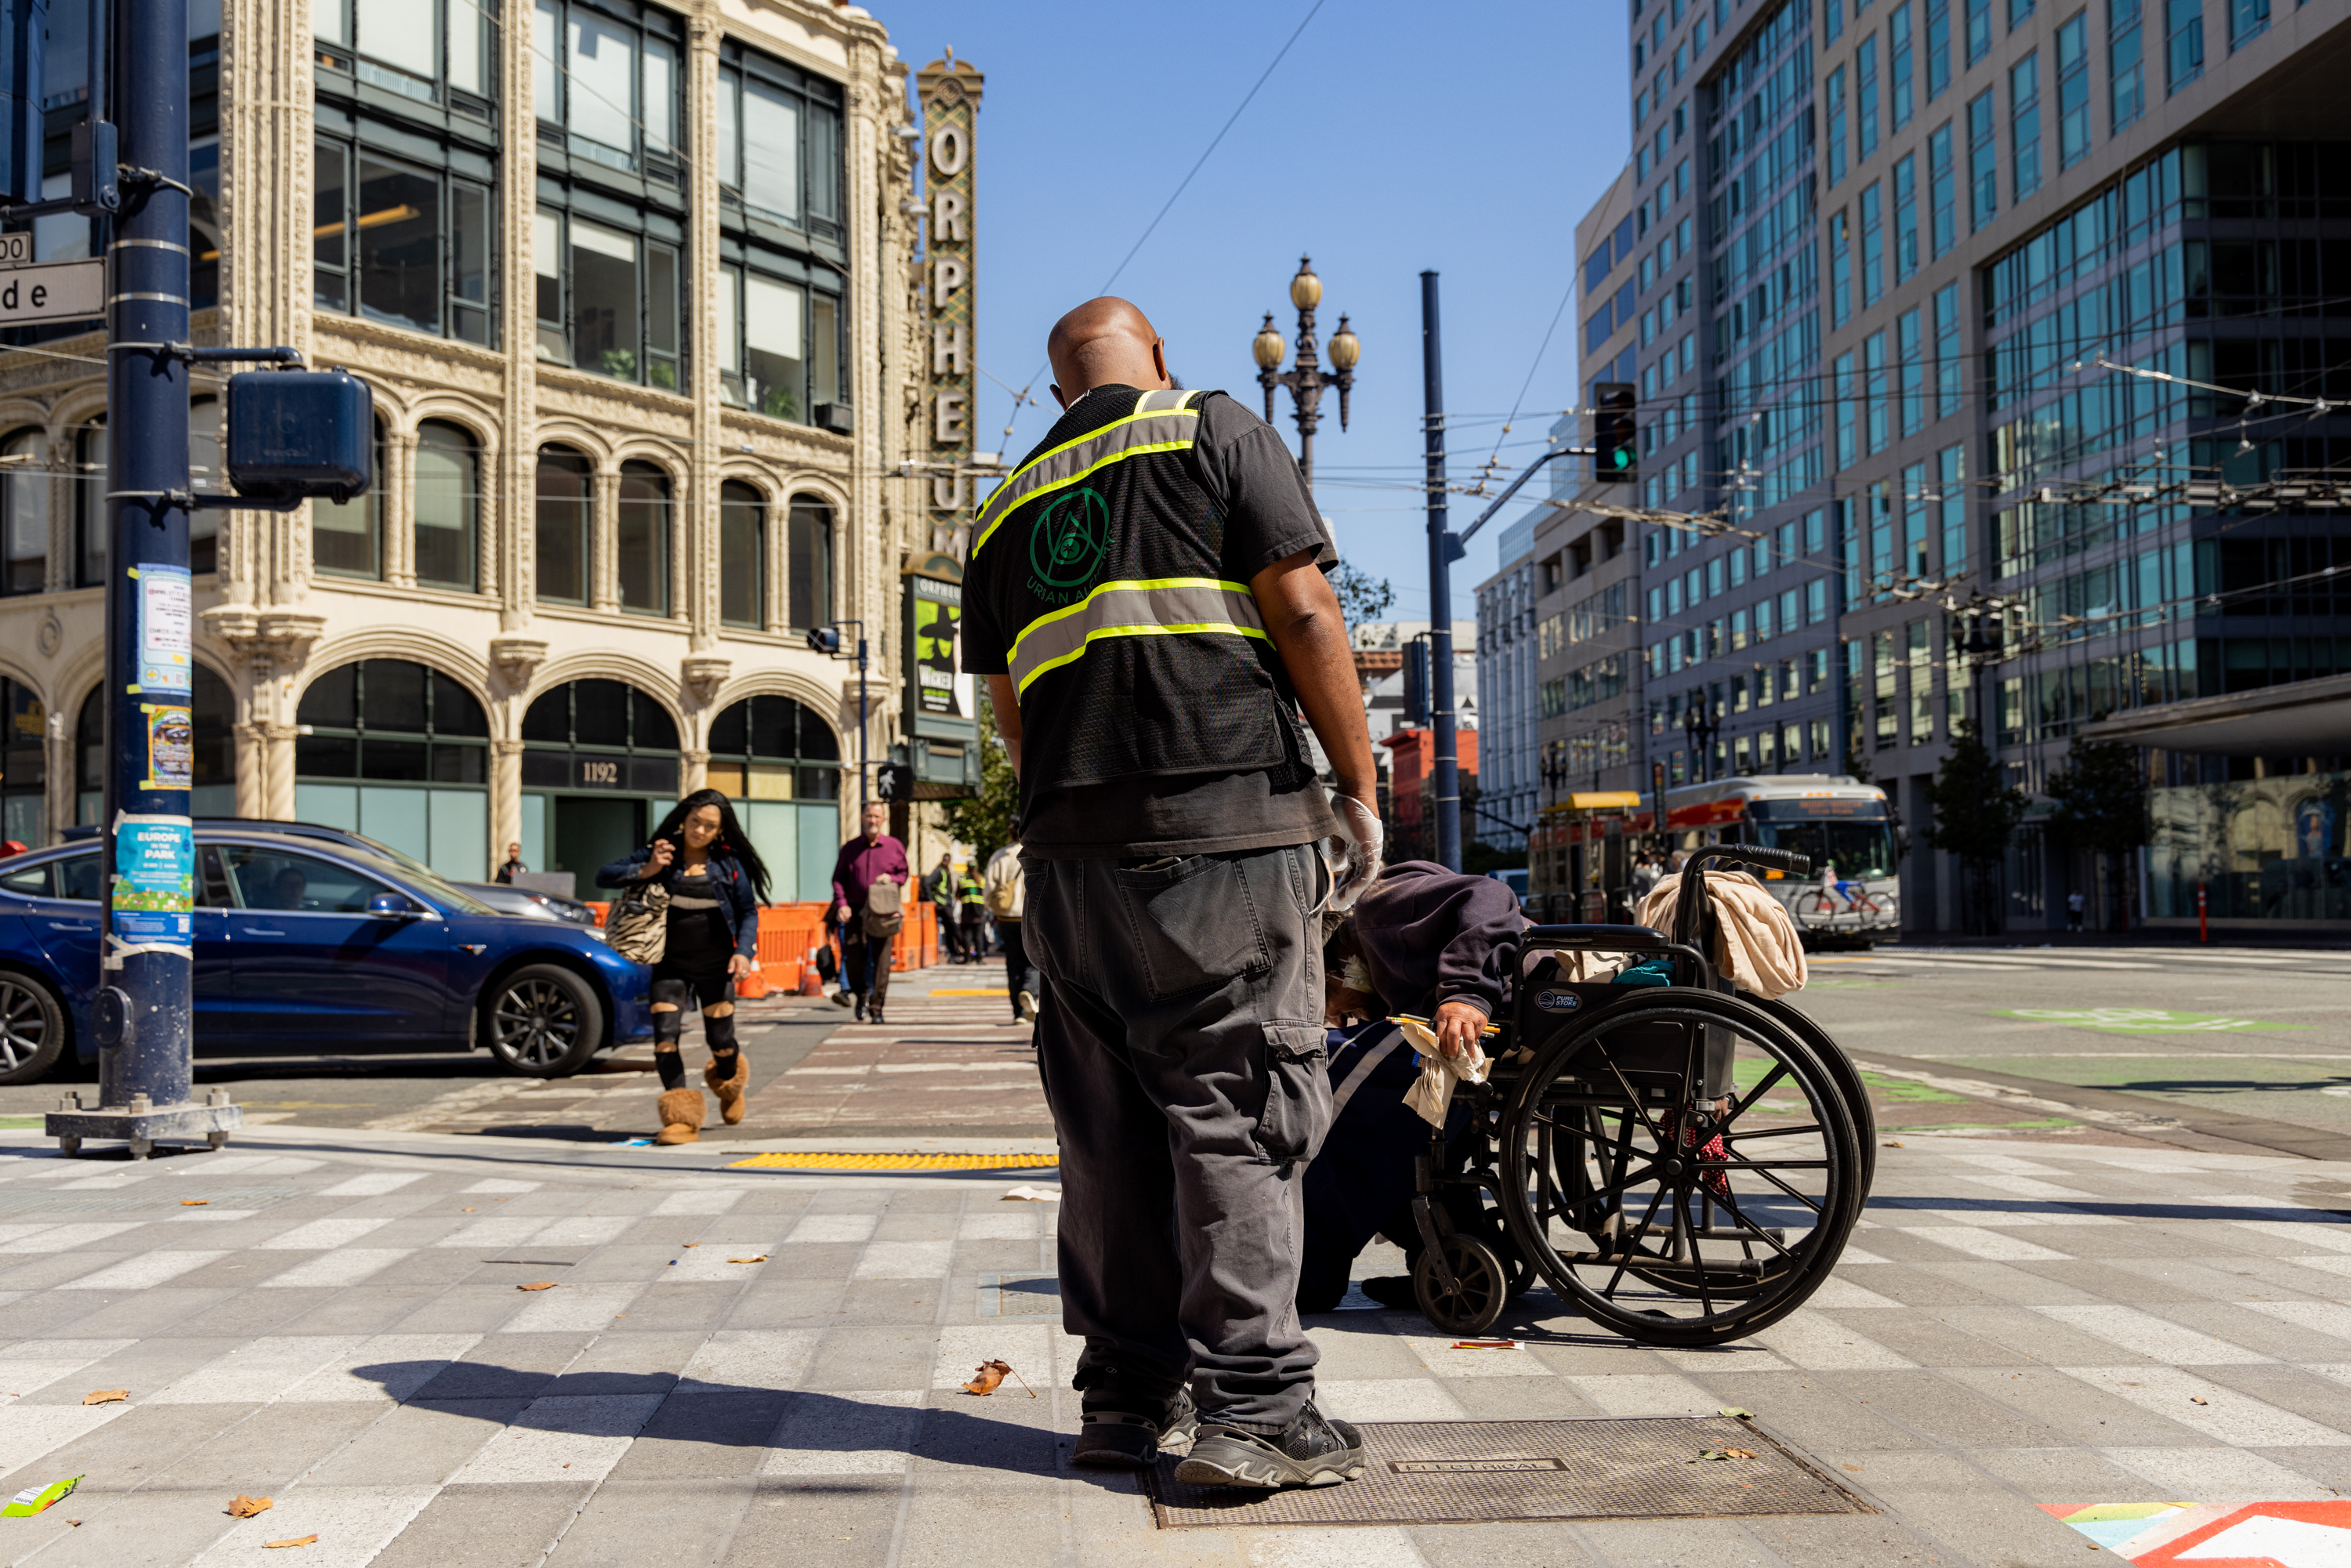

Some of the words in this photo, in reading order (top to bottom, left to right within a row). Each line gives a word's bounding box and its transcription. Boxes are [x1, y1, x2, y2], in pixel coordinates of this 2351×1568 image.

[2, 279, 47, 310] de
[931, 121, 970, 574] ORPHEUM
[1027, 575, 1069, 604] URBAN
[584, 761, 618, 783] 1192
[137, 832, 181, 843] EUROPE
[144, 849, 176, 860] PARK
[1405, 1462, 1547, 1471] ELECTRICAL
